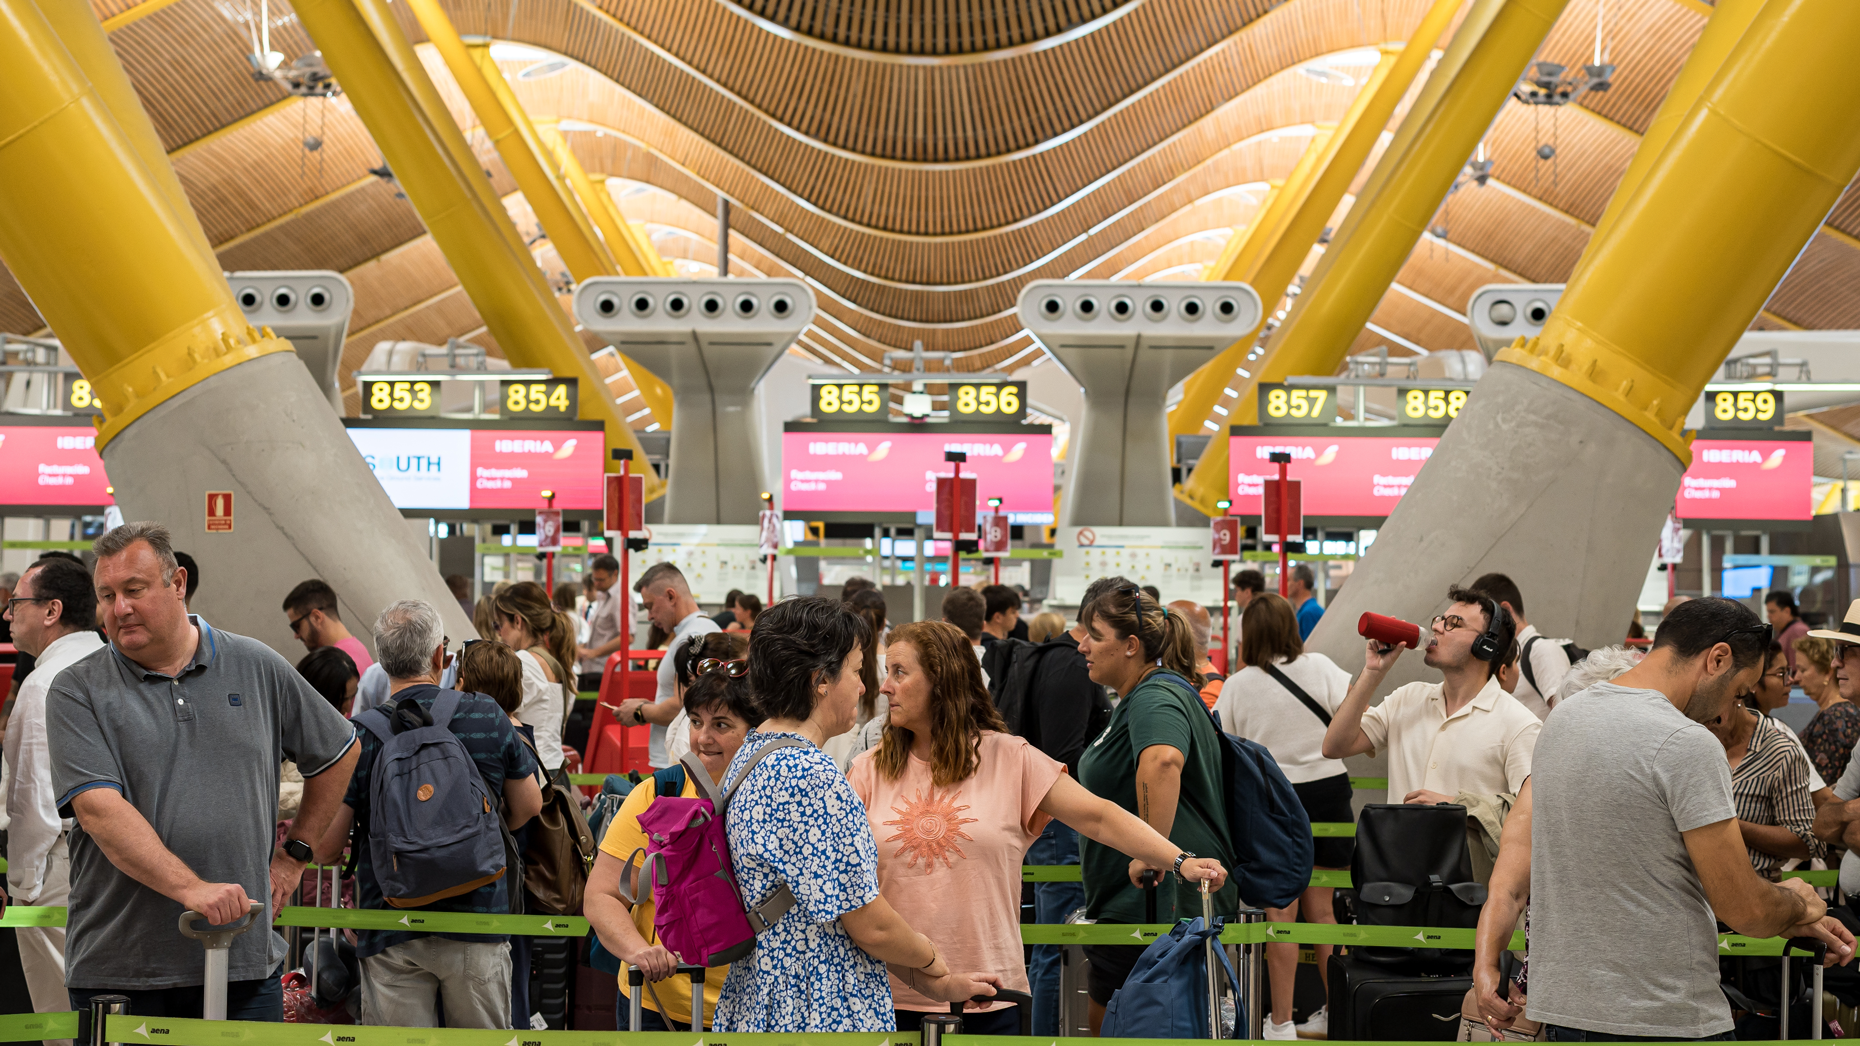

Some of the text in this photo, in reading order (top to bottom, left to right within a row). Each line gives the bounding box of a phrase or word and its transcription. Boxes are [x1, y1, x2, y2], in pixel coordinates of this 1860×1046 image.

[370, 382, 432, 411] 853
[506, 383, 570, 412] 854
[819, 385, 881, 413] 855
[957, 385, 1020, 414] 856
[1267, 389, 1328, 418] 857
[1405, 390, 1468, 418] 858
[1714, 392, 1776, 421] 859
[495, 440, 554, 453] IBERIA
[808, 442, 868, 455] IBERIA
[1702, 449, 1762, 463] IBERIA
[476, 467, 528, 478] Facturación
[476, 478, 500, 489] Check
[1684, 476, 1737, 488] Facturación
[1684, 489, 1709, 499] Check
[545, 521, 554, 536] 6
[991, 526, 1001, 542] 8
[1219, 529, 1231, 544] 9
[150, 1027, 170, 1035] aena
[335, 1035, 356, 1043] aena
